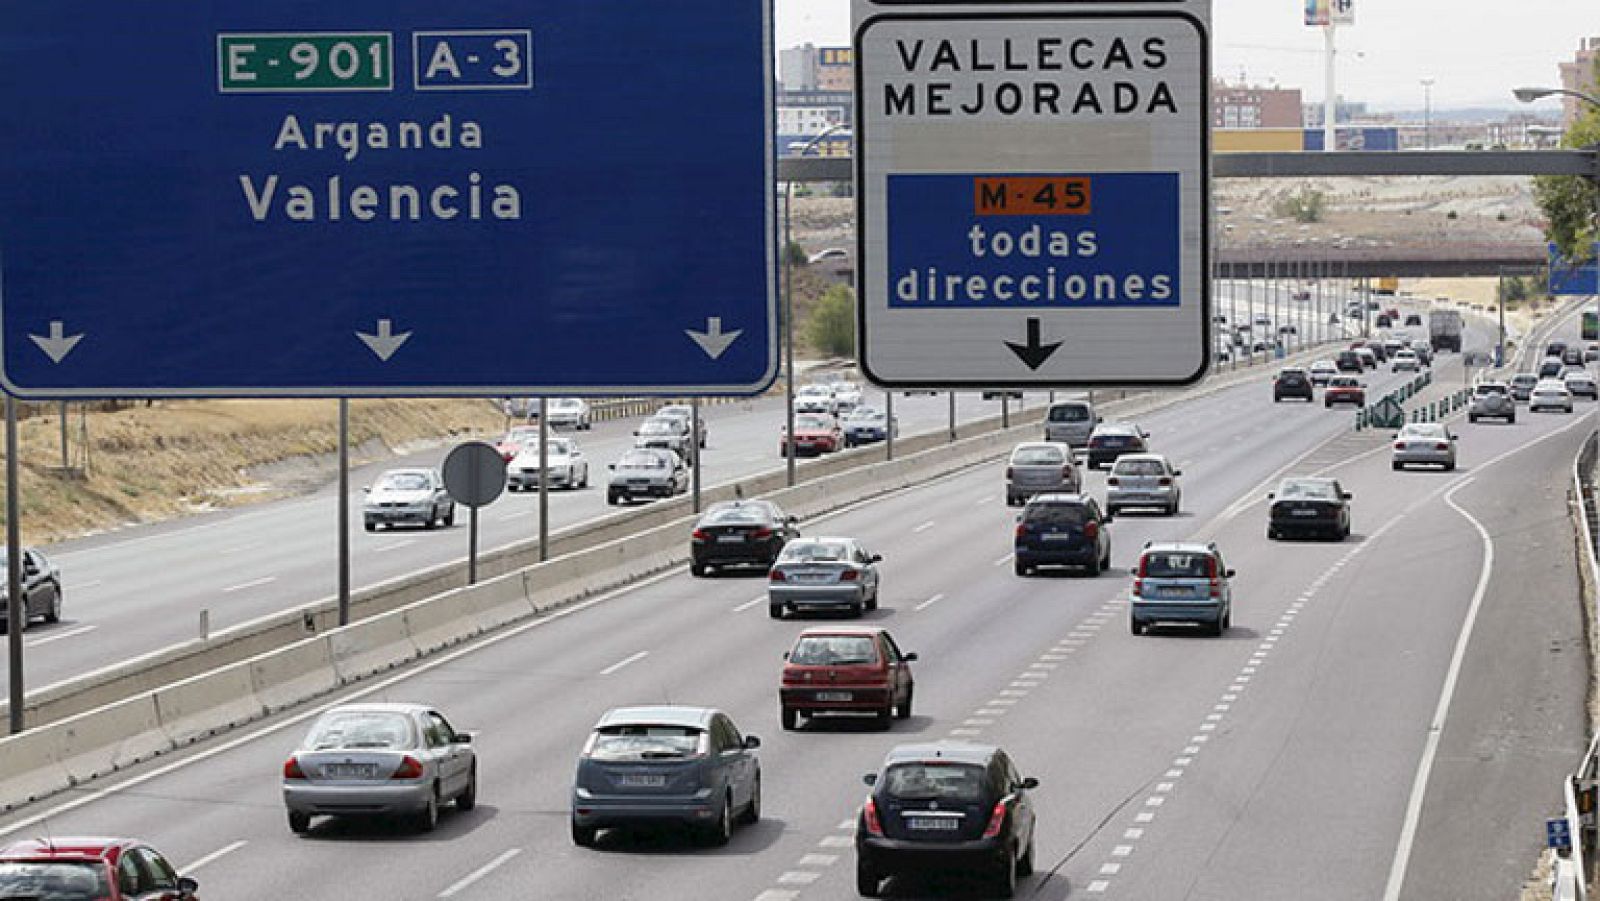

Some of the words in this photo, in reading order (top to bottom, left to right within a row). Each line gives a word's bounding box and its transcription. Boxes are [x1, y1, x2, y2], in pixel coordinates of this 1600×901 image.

[228, 41, 381, 80] E-901
[427, 39, 521, 77] A-3
[896, 37, 1166, 71] VALLECAS
[885, 81, 1178, 115] MEJORADA
[274, 114, 481, 160] Arganda
[240, 172, 519, 219] Valencia
[981, 181, 1085, 208] M-45
[968, 224, 1096, 256] todas
[897, 266, 1170, 300] direcciones
